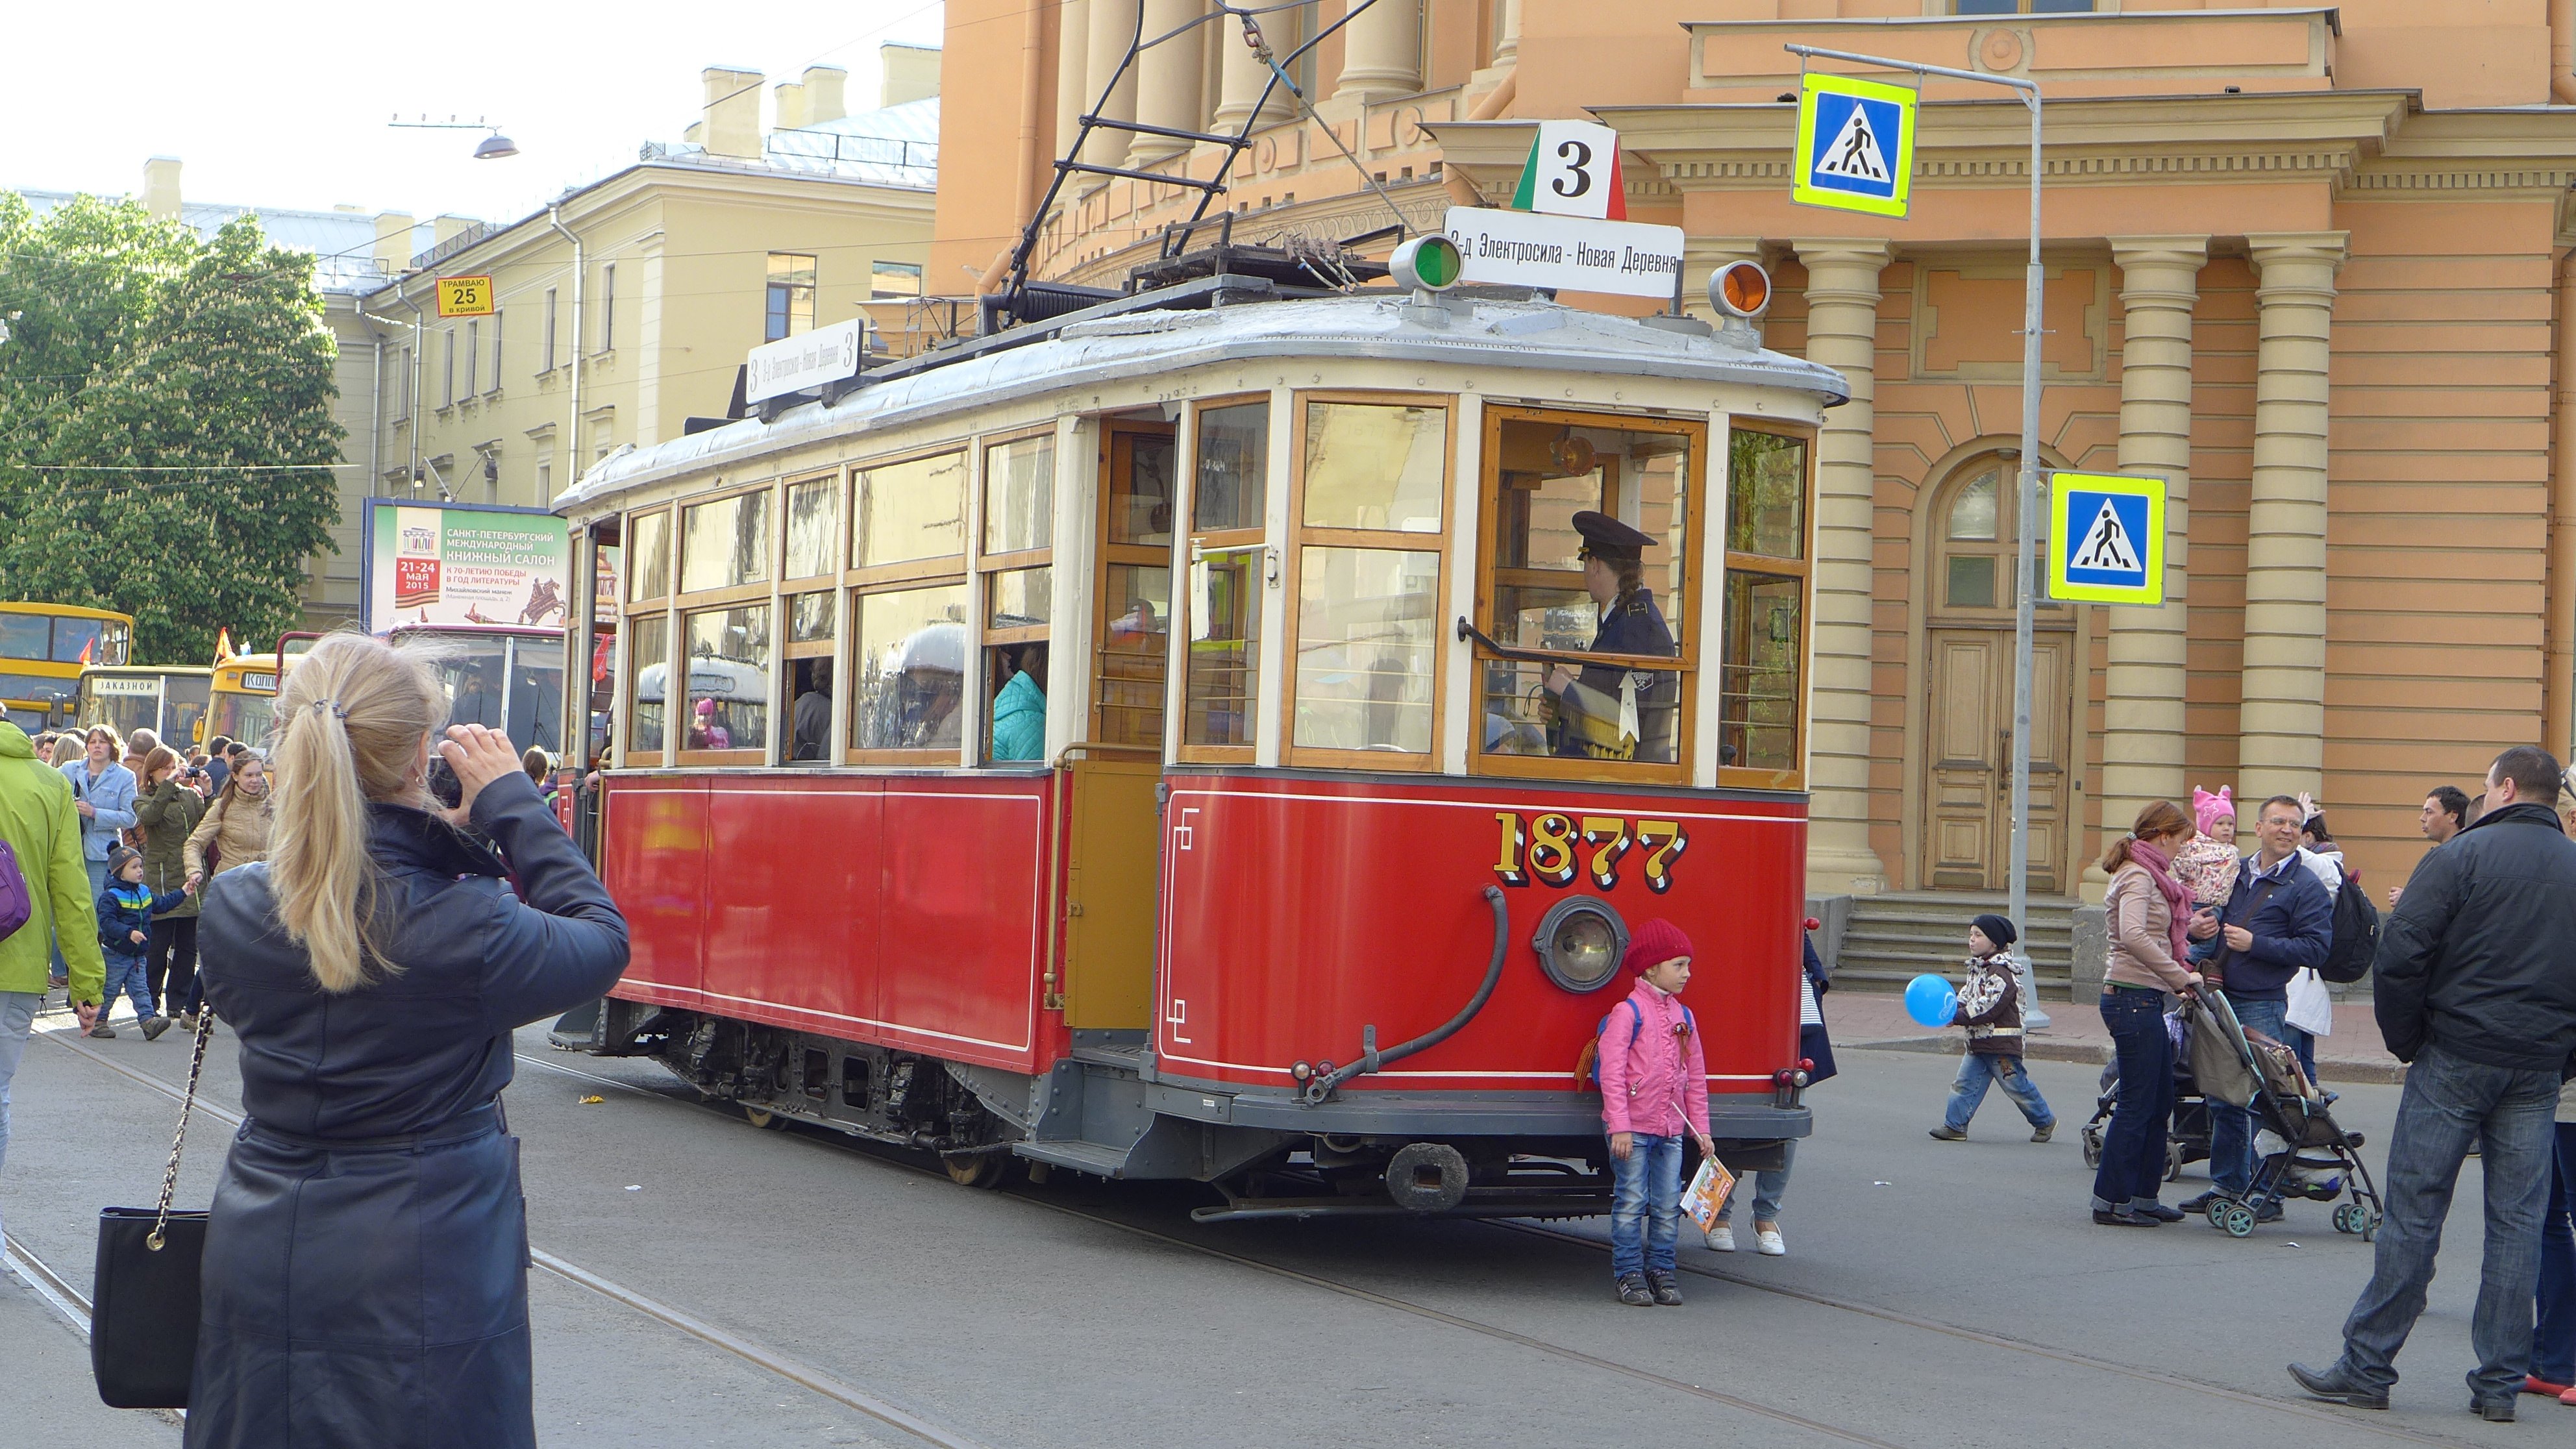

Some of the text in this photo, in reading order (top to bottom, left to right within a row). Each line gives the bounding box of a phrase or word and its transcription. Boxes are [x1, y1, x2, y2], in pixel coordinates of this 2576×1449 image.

[1552, 140, 1592, 197] 3
[1479, 232, 1562, 265] Электросила
[1576, 241, 1616, 269] Новая
[1621, 245, 1678, 275] Деревня
[442, 279, 485, 288] ТРАМВАЮ
[453, 288, 477, 304] 25
[456, 304, 485, 314] кривой
[750, 358, 758, 393] 3
[843, 332, 854, 367] 3
[447, 528, 554, 542] САНКТ-ПЕТЕРБУРГСКИЙ
[447, 539, 534, 551] МЕЖДУНАРОДНЫЙ
[446, 549, 555, 565] КНИЖНЫЙ САЛОН
[401, 562, 435, 573] 21-24
[494, 569, 526, 577] ПОБЕДЫ
[406, 573, 428, 581] мая
[471, 577, 520, 586] ЛИТЕРАТУРЫ
[101, 681, 153, 690] ЗАКАЗНОЙ
[247, 673, 277, 687] Колп
[1493, 811, 1689, 895] 1877
